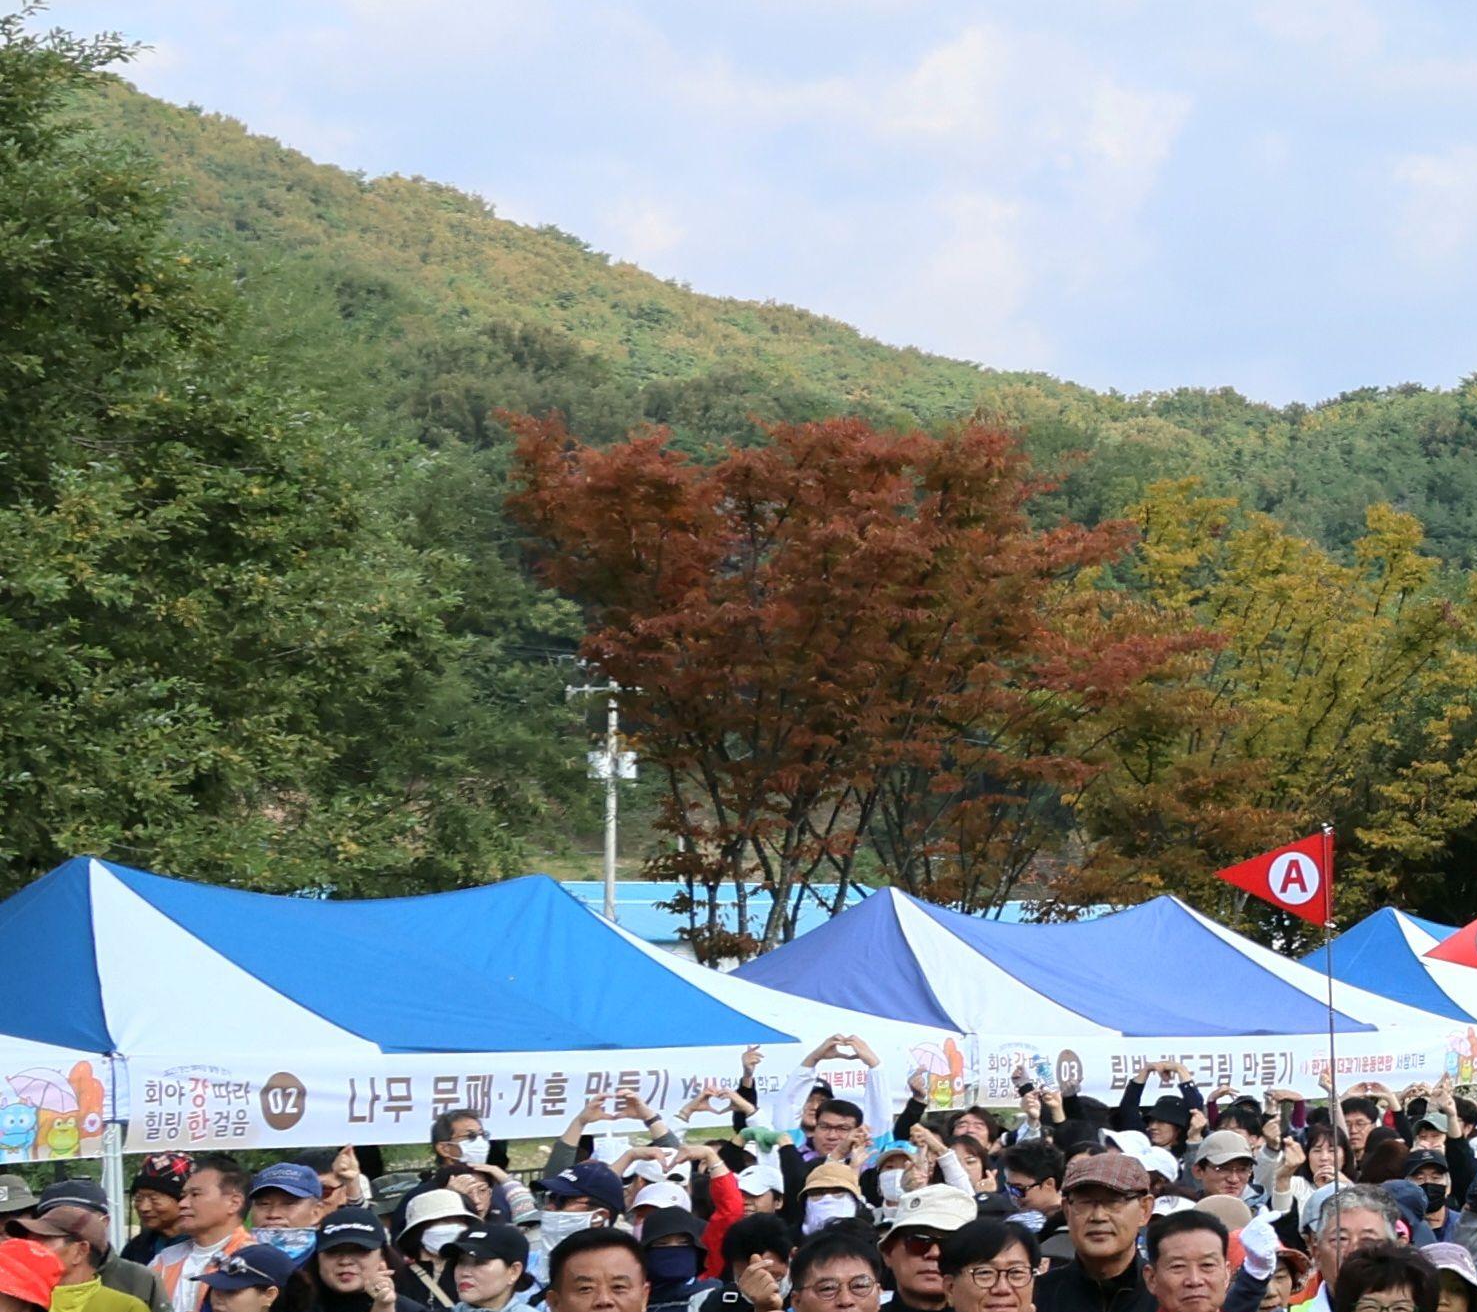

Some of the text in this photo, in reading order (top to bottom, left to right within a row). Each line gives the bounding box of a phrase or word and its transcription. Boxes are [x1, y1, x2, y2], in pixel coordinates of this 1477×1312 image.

[1279, 859, 1309, 894] A
[1060, 1061, 1080, 1083] 03
[1242, 1051, 1294, 1088] 만들기
[268, 1087, 299, 1115] 02
[348, 1076, 413, 1124] 나무
[145, 1111, 182, 1140] 힐링
[213, 1108, 251, 1137] 걸음
